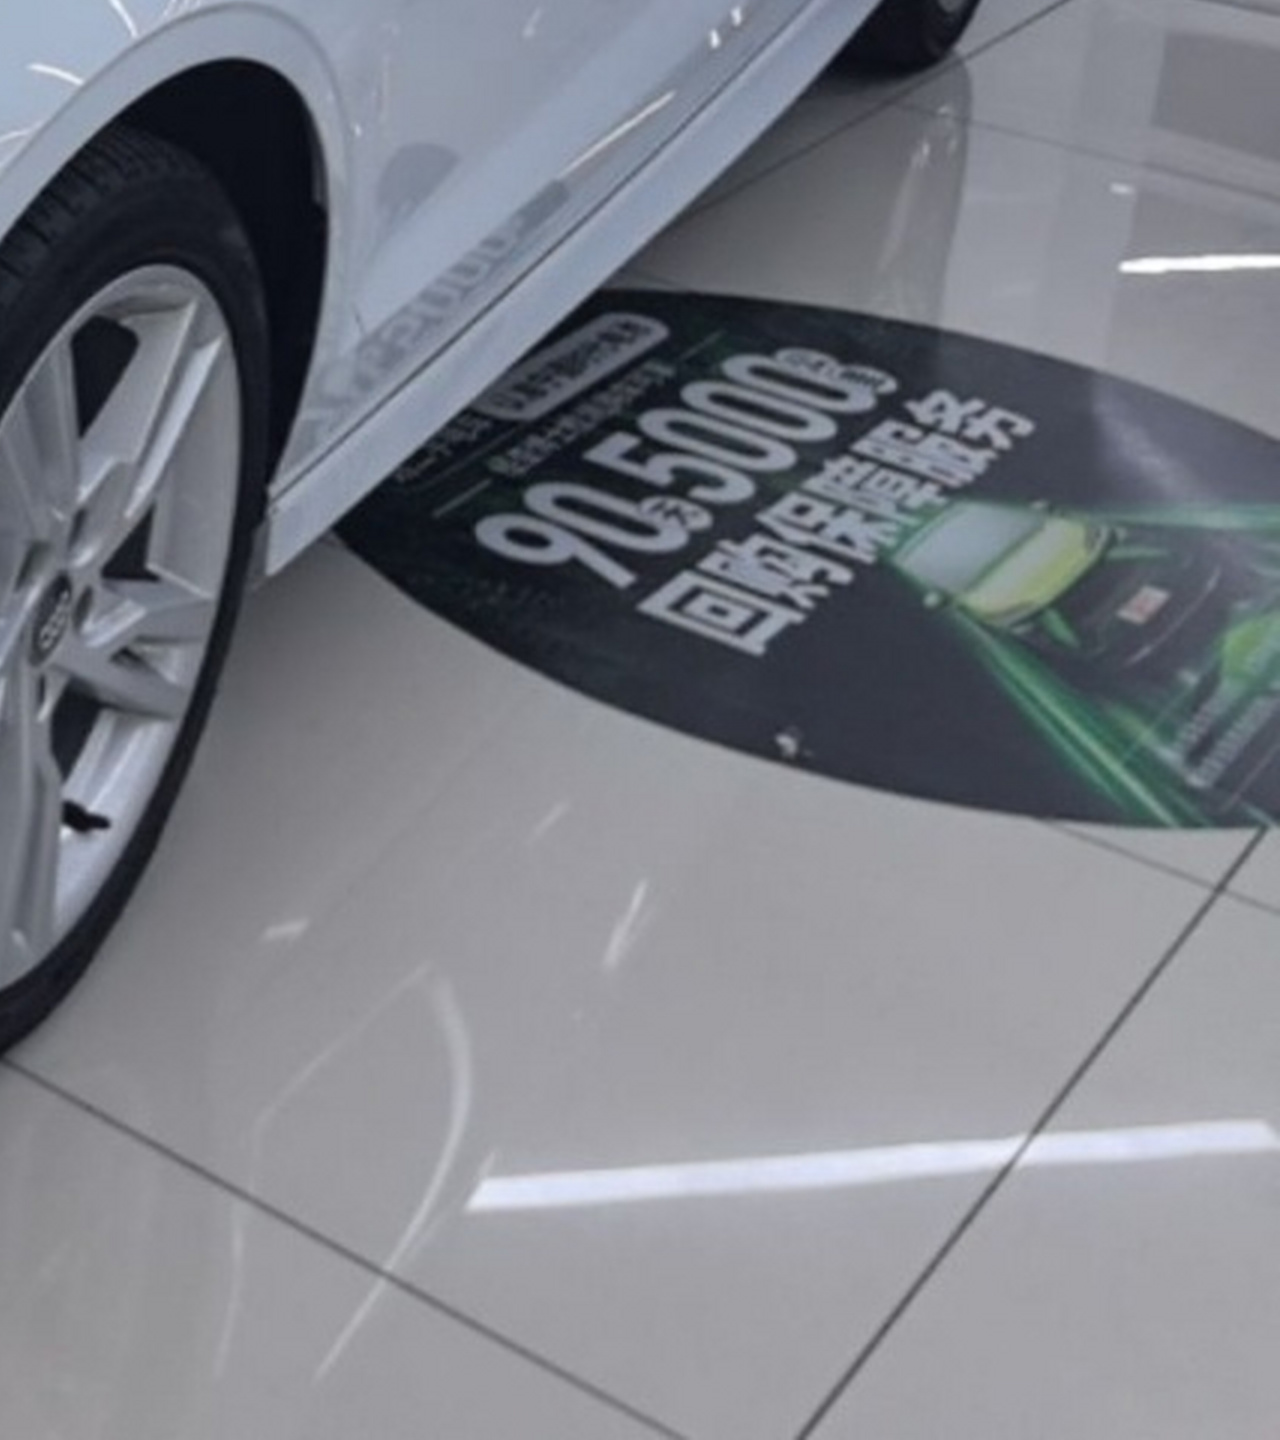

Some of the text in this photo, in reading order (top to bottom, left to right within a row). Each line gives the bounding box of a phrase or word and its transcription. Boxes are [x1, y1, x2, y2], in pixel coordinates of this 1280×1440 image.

[636, 389, 1037, 657] 回购保障服务
